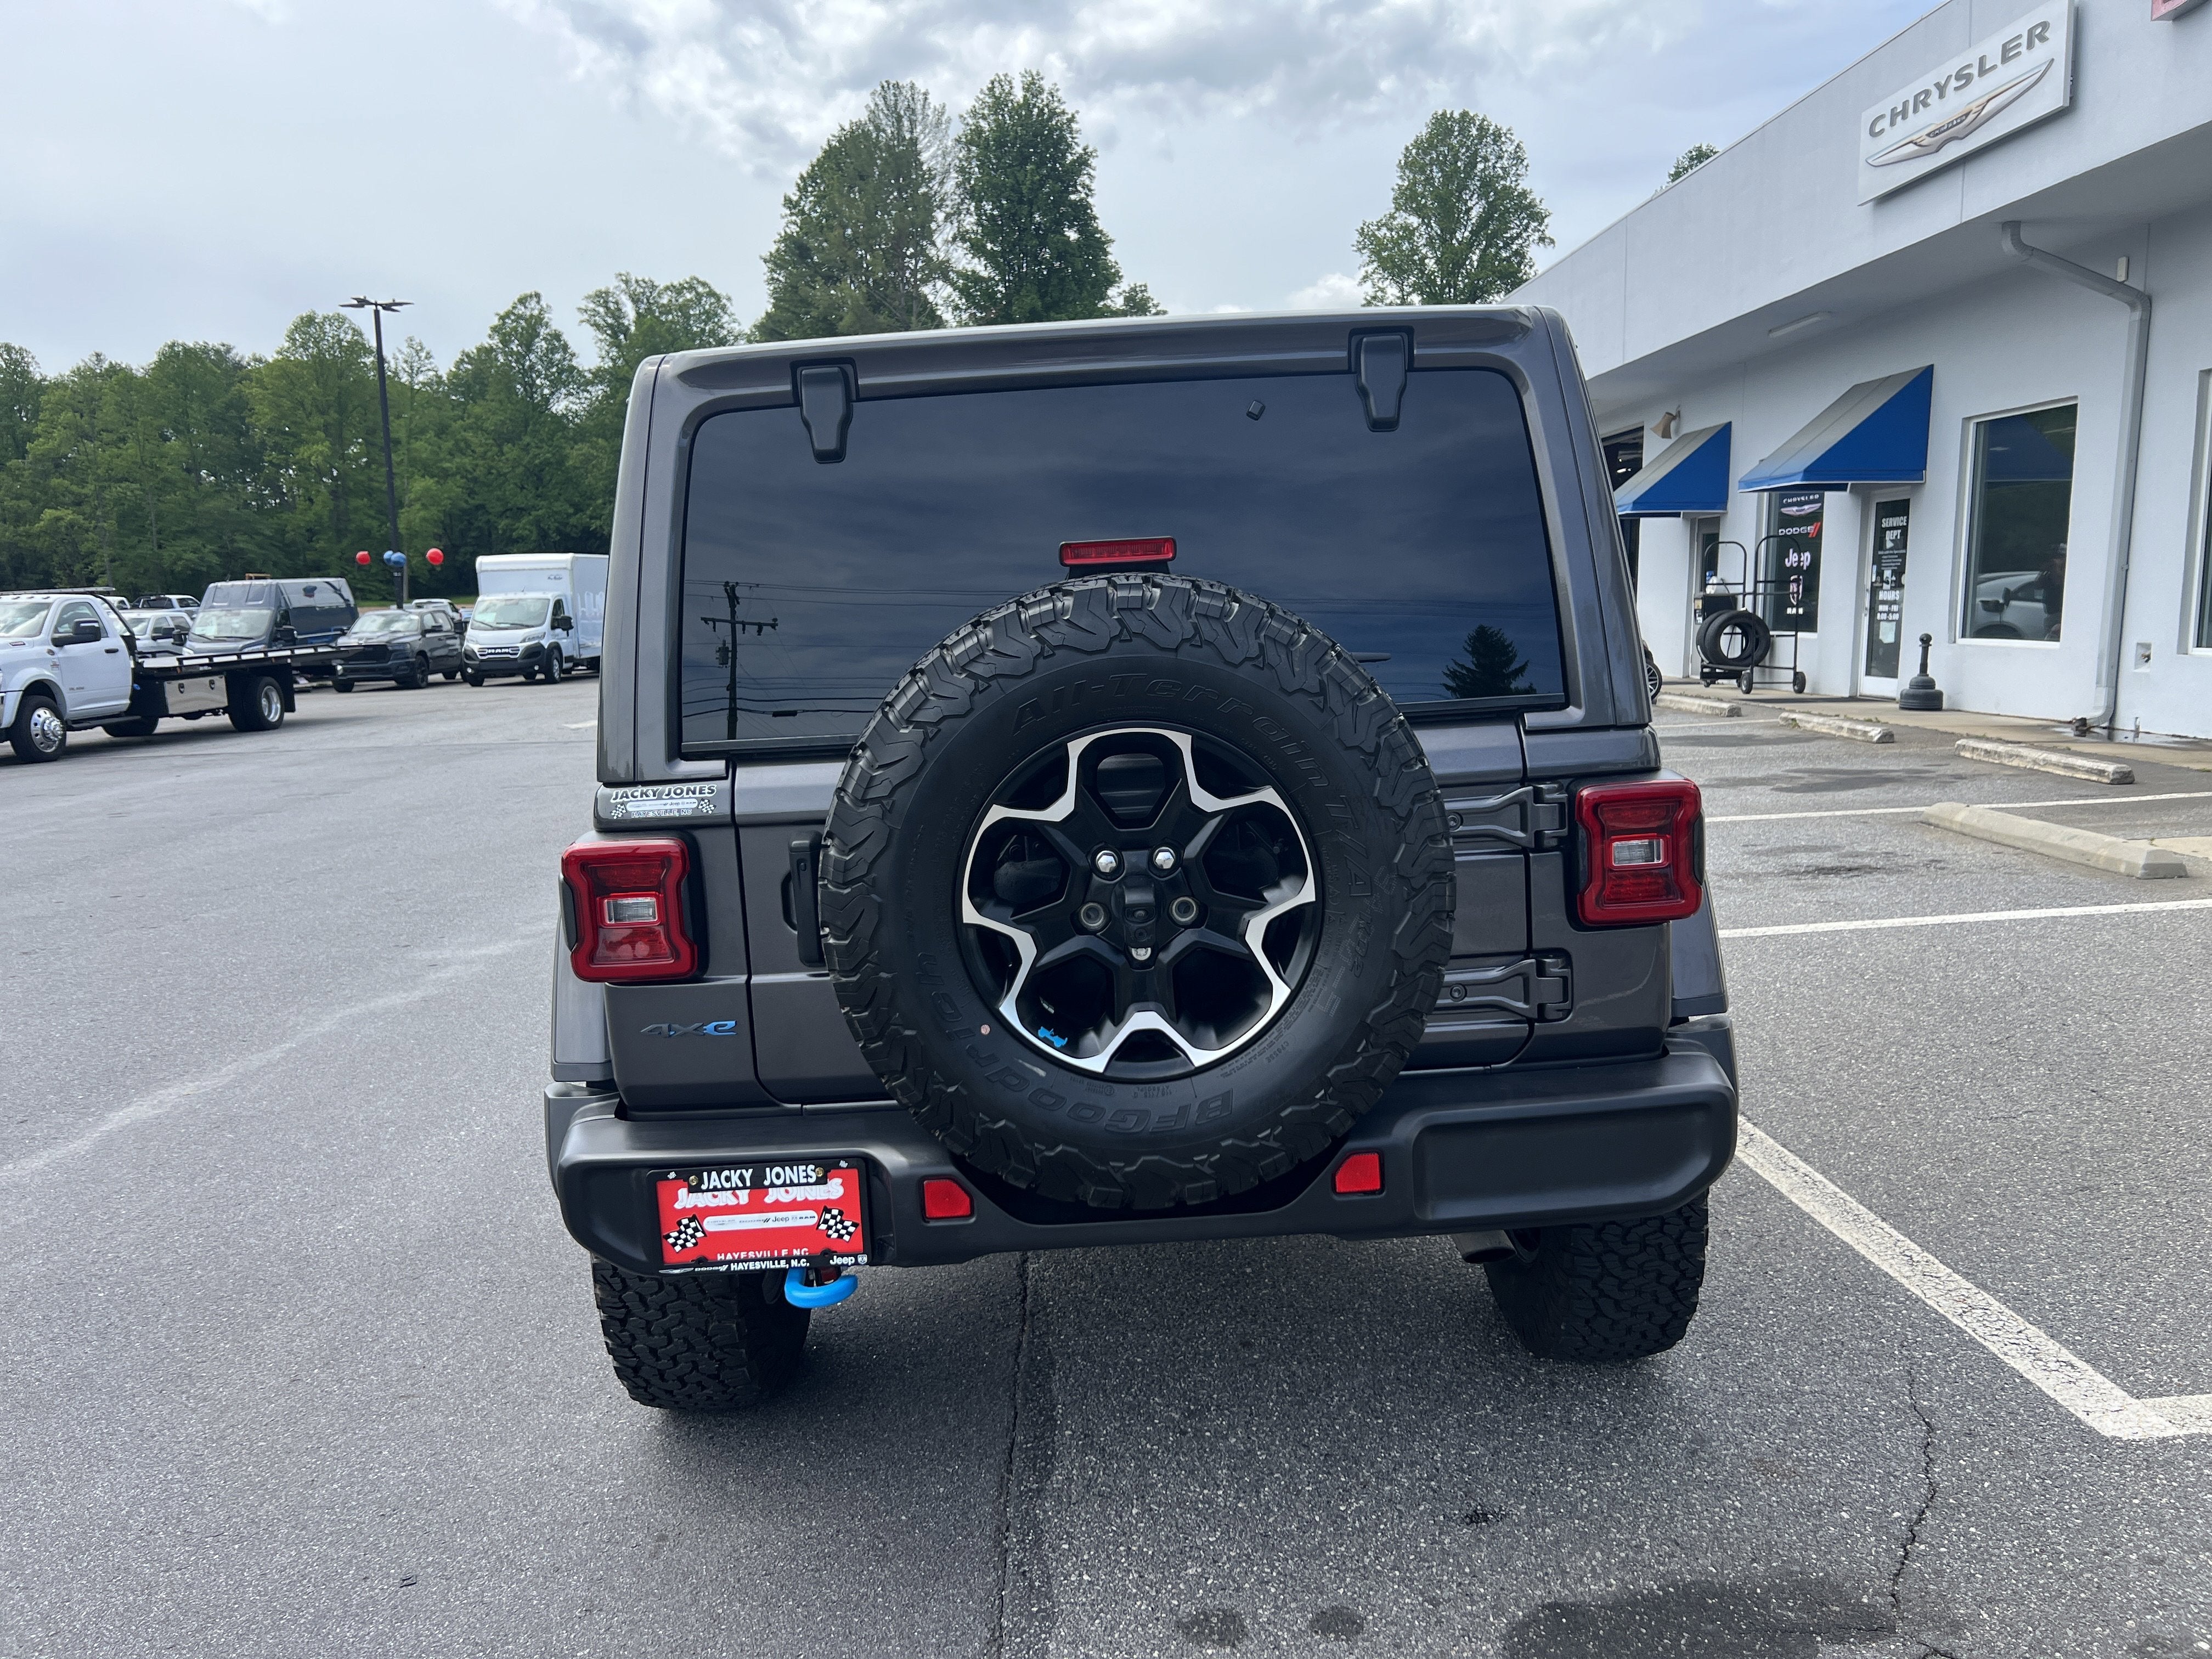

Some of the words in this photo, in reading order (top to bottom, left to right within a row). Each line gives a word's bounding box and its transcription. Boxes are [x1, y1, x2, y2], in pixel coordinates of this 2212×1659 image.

[1869, 20, 2051, 138] CHRYSLER
[1779, 525, 1814, 535] DODGE
[1882, 516, 1907, 528] SERVICE
[1886, 529, 1901, 540] DEPT
[1785, 548, 1811, 571] Jeep
[1878, 590, 1900, 601] HOURS
[611, 787, 661, 803] JACKY
[663, 785, 717, 799] JONES
[1012, 673, 1329, 787] All-Terrain
[1324, 794, 1372, 897] T/A
[915, 952, 1234, 1133] BFGoodrich
[701, 1168, 753, 1190] JACKY
[763, 1164, 816, 1186] JONES
[674, 1187, 751, 1209] JACKY
[764, 1178, 844, 1203] JONES
[730, 1260, 789, 1271] HAYESVILLE,
[791, 1259, 810, 1267] N.C.
[830, 1255, 855, 1265] Jeep
